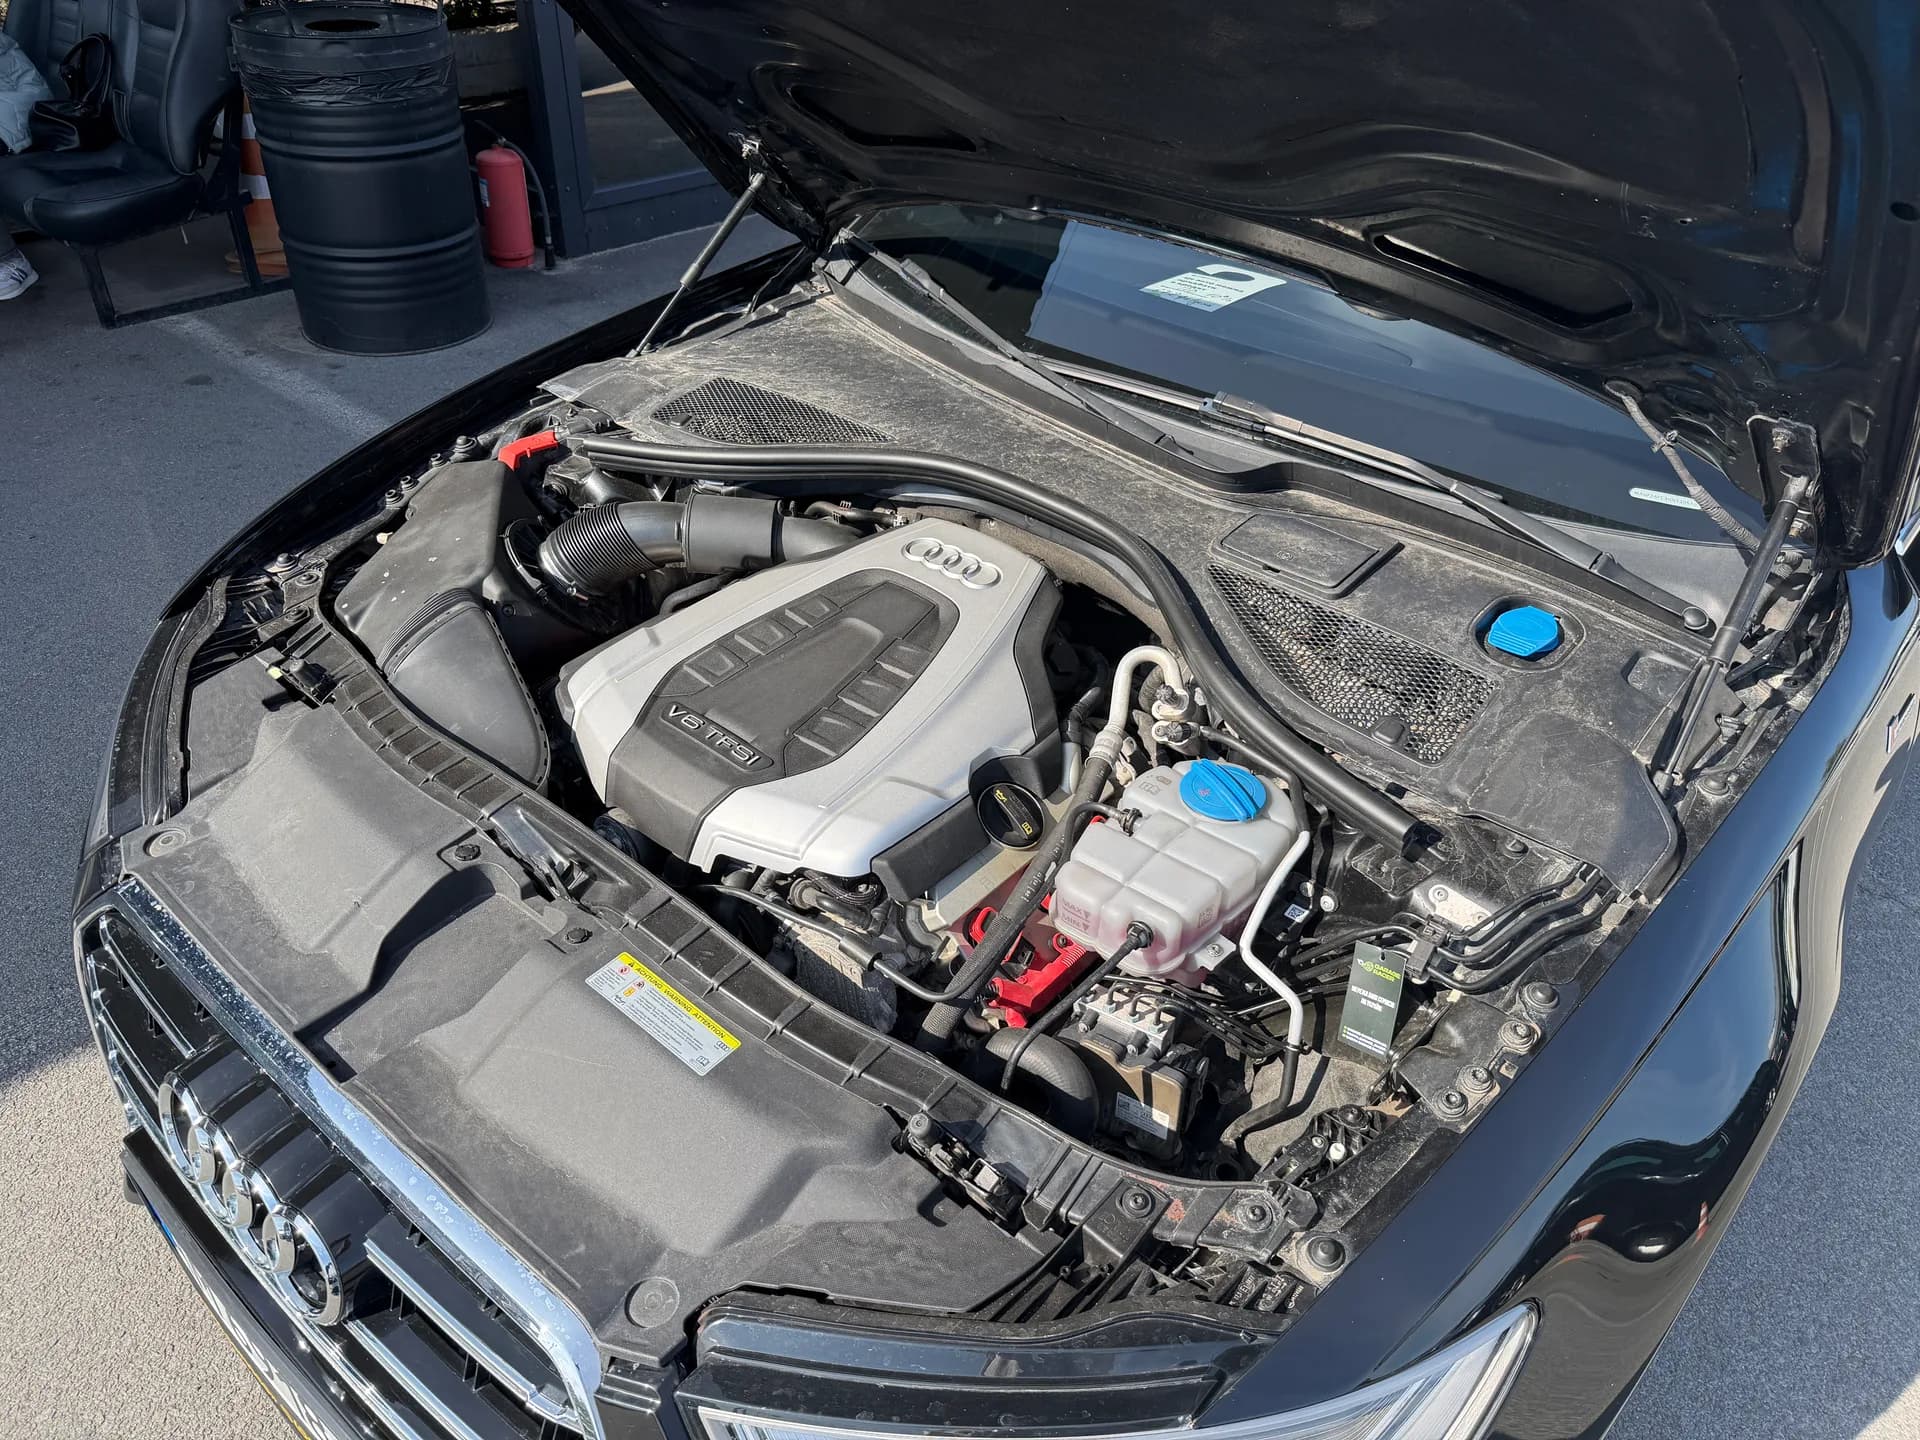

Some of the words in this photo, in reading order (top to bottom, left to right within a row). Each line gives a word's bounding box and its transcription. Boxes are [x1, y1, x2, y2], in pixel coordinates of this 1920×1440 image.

[668, 704, 705, 730] V6
[705, 726, 761, 766] TFSI
[636, 967, 663, 990] ACHTUNG
[663, 987, 693, 1013] WARNING
[693, 1010, 726, 1039] ATTENTION
